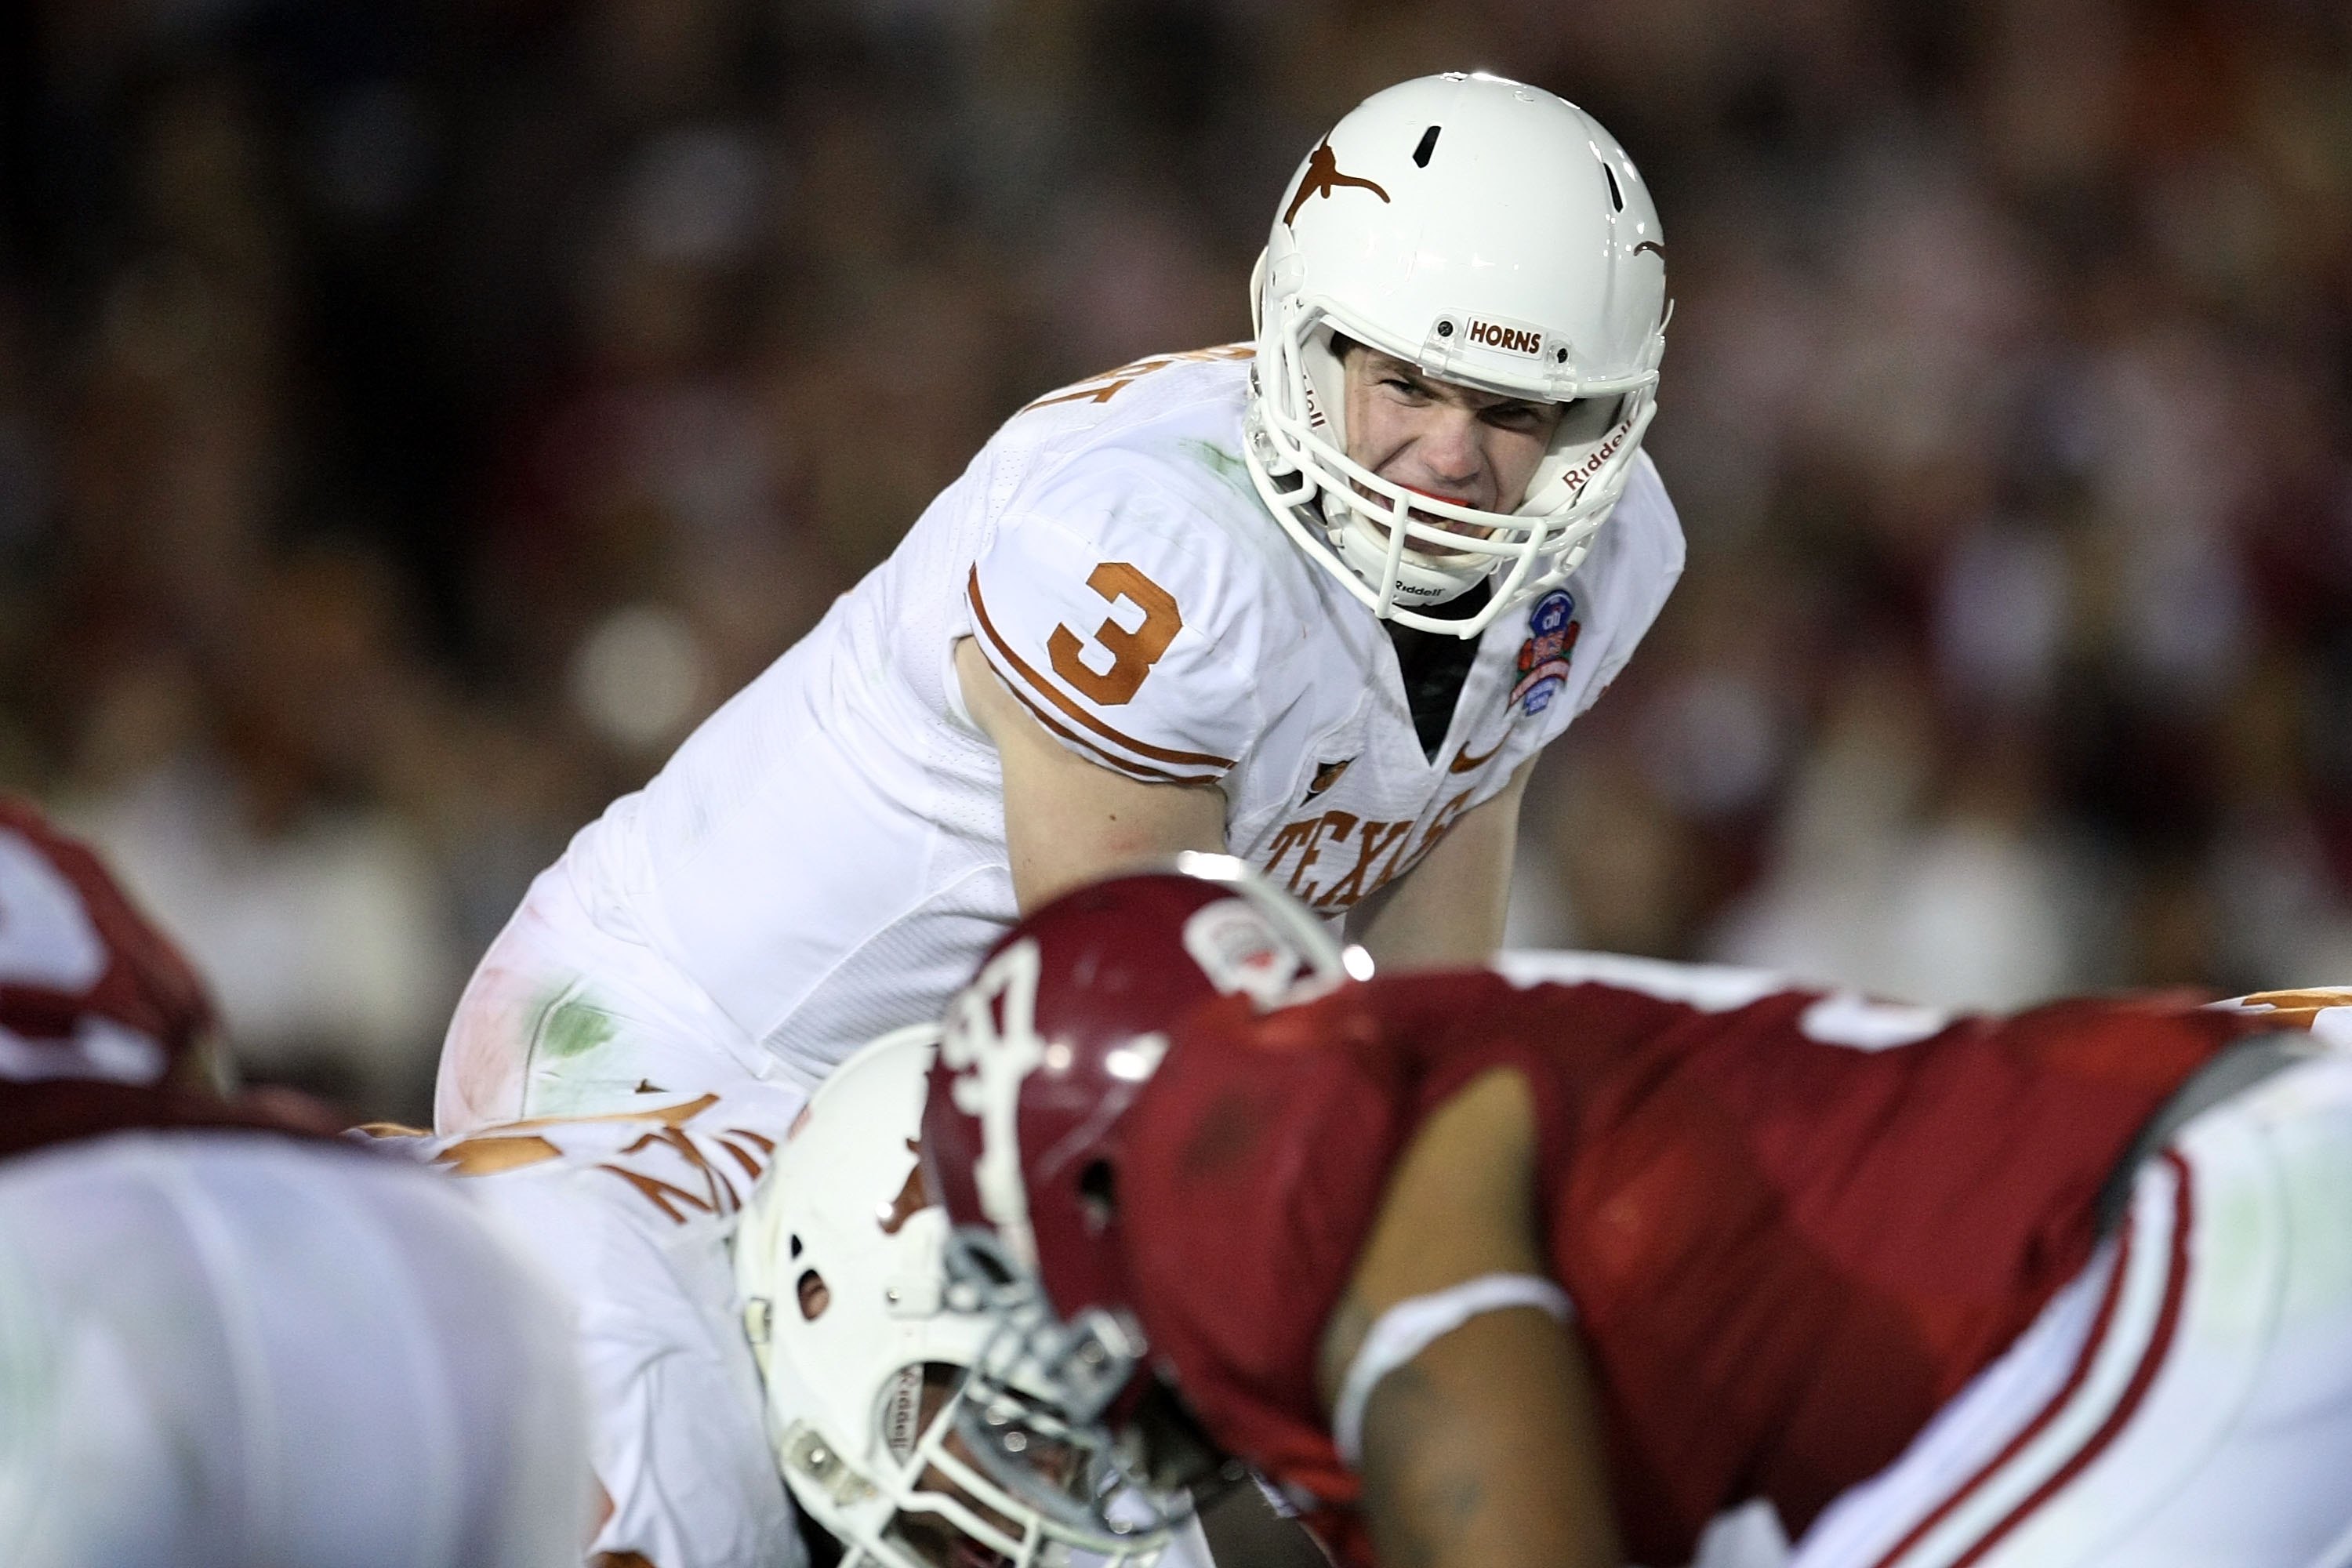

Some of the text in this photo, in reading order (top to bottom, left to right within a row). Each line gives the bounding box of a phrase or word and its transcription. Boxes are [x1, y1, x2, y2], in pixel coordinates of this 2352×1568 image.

[1469, 320, 1542, 354] HORNS
[1563, 419, 1632, 491] Riddell
[1396, 580, 1443, 596] Riddell
[1046, 561, 1184, 706] 3
